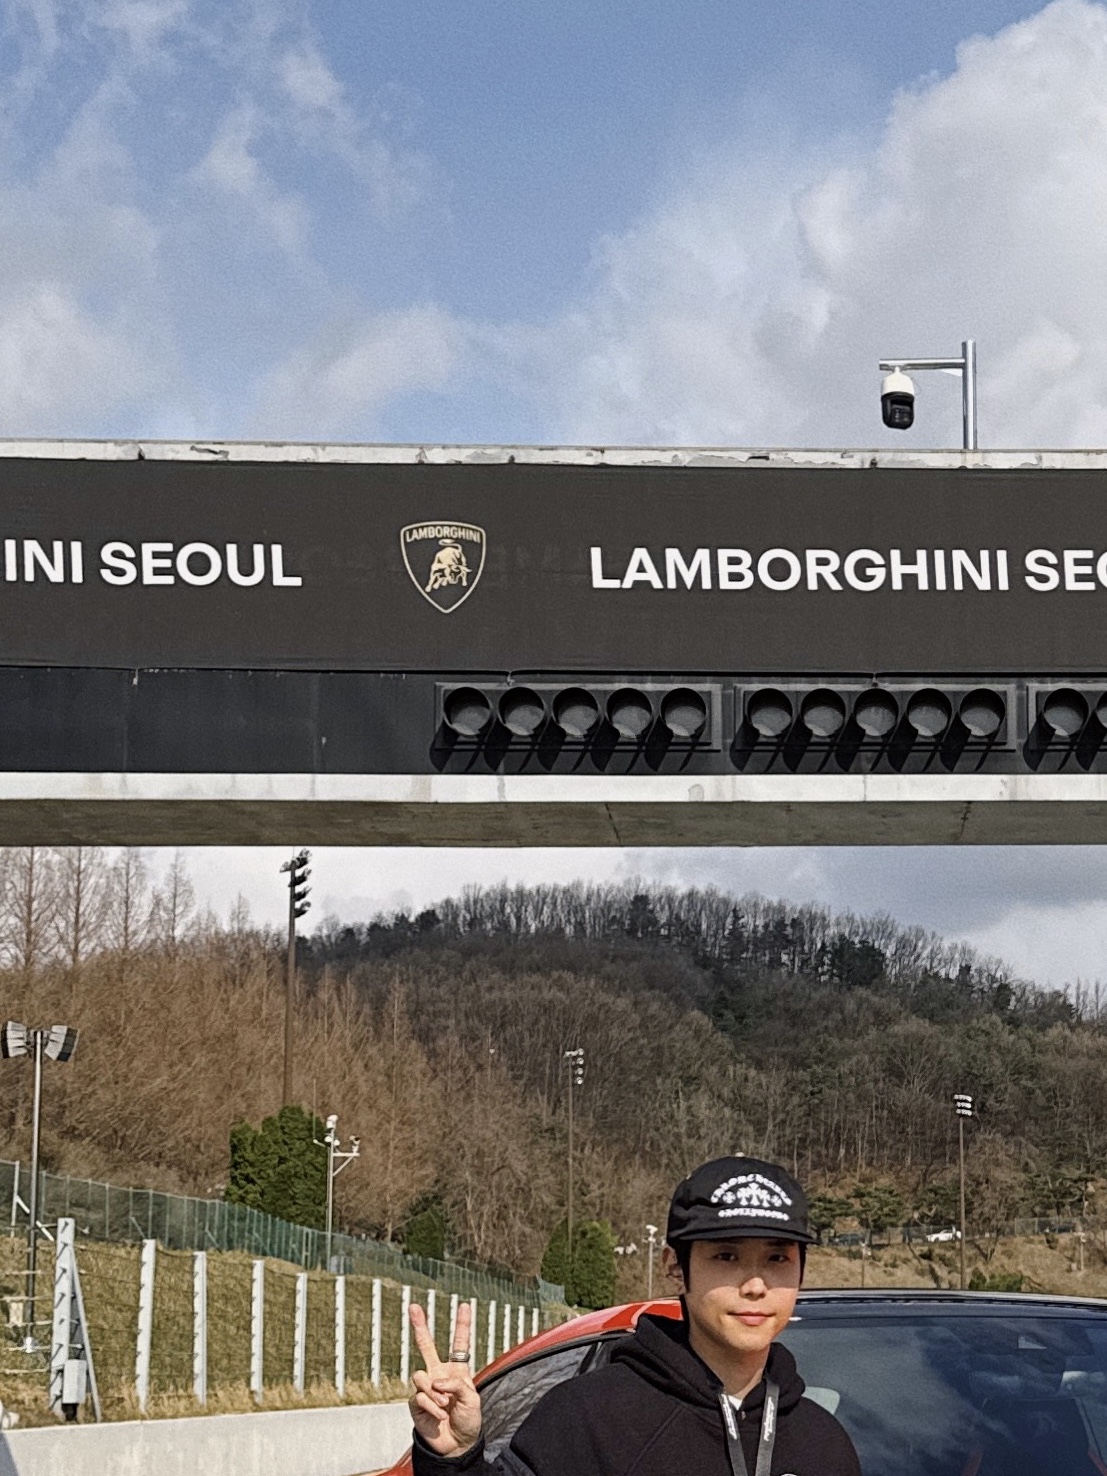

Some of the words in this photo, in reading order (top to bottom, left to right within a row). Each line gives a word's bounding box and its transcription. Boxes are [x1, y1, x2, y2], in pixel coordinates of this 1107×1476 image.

[405, 525, 481, 544] LAMBORGHINI
[99, 541, 304, 588] SEOUL
[590, 546, 1009, 592] LAMBORGHINI
